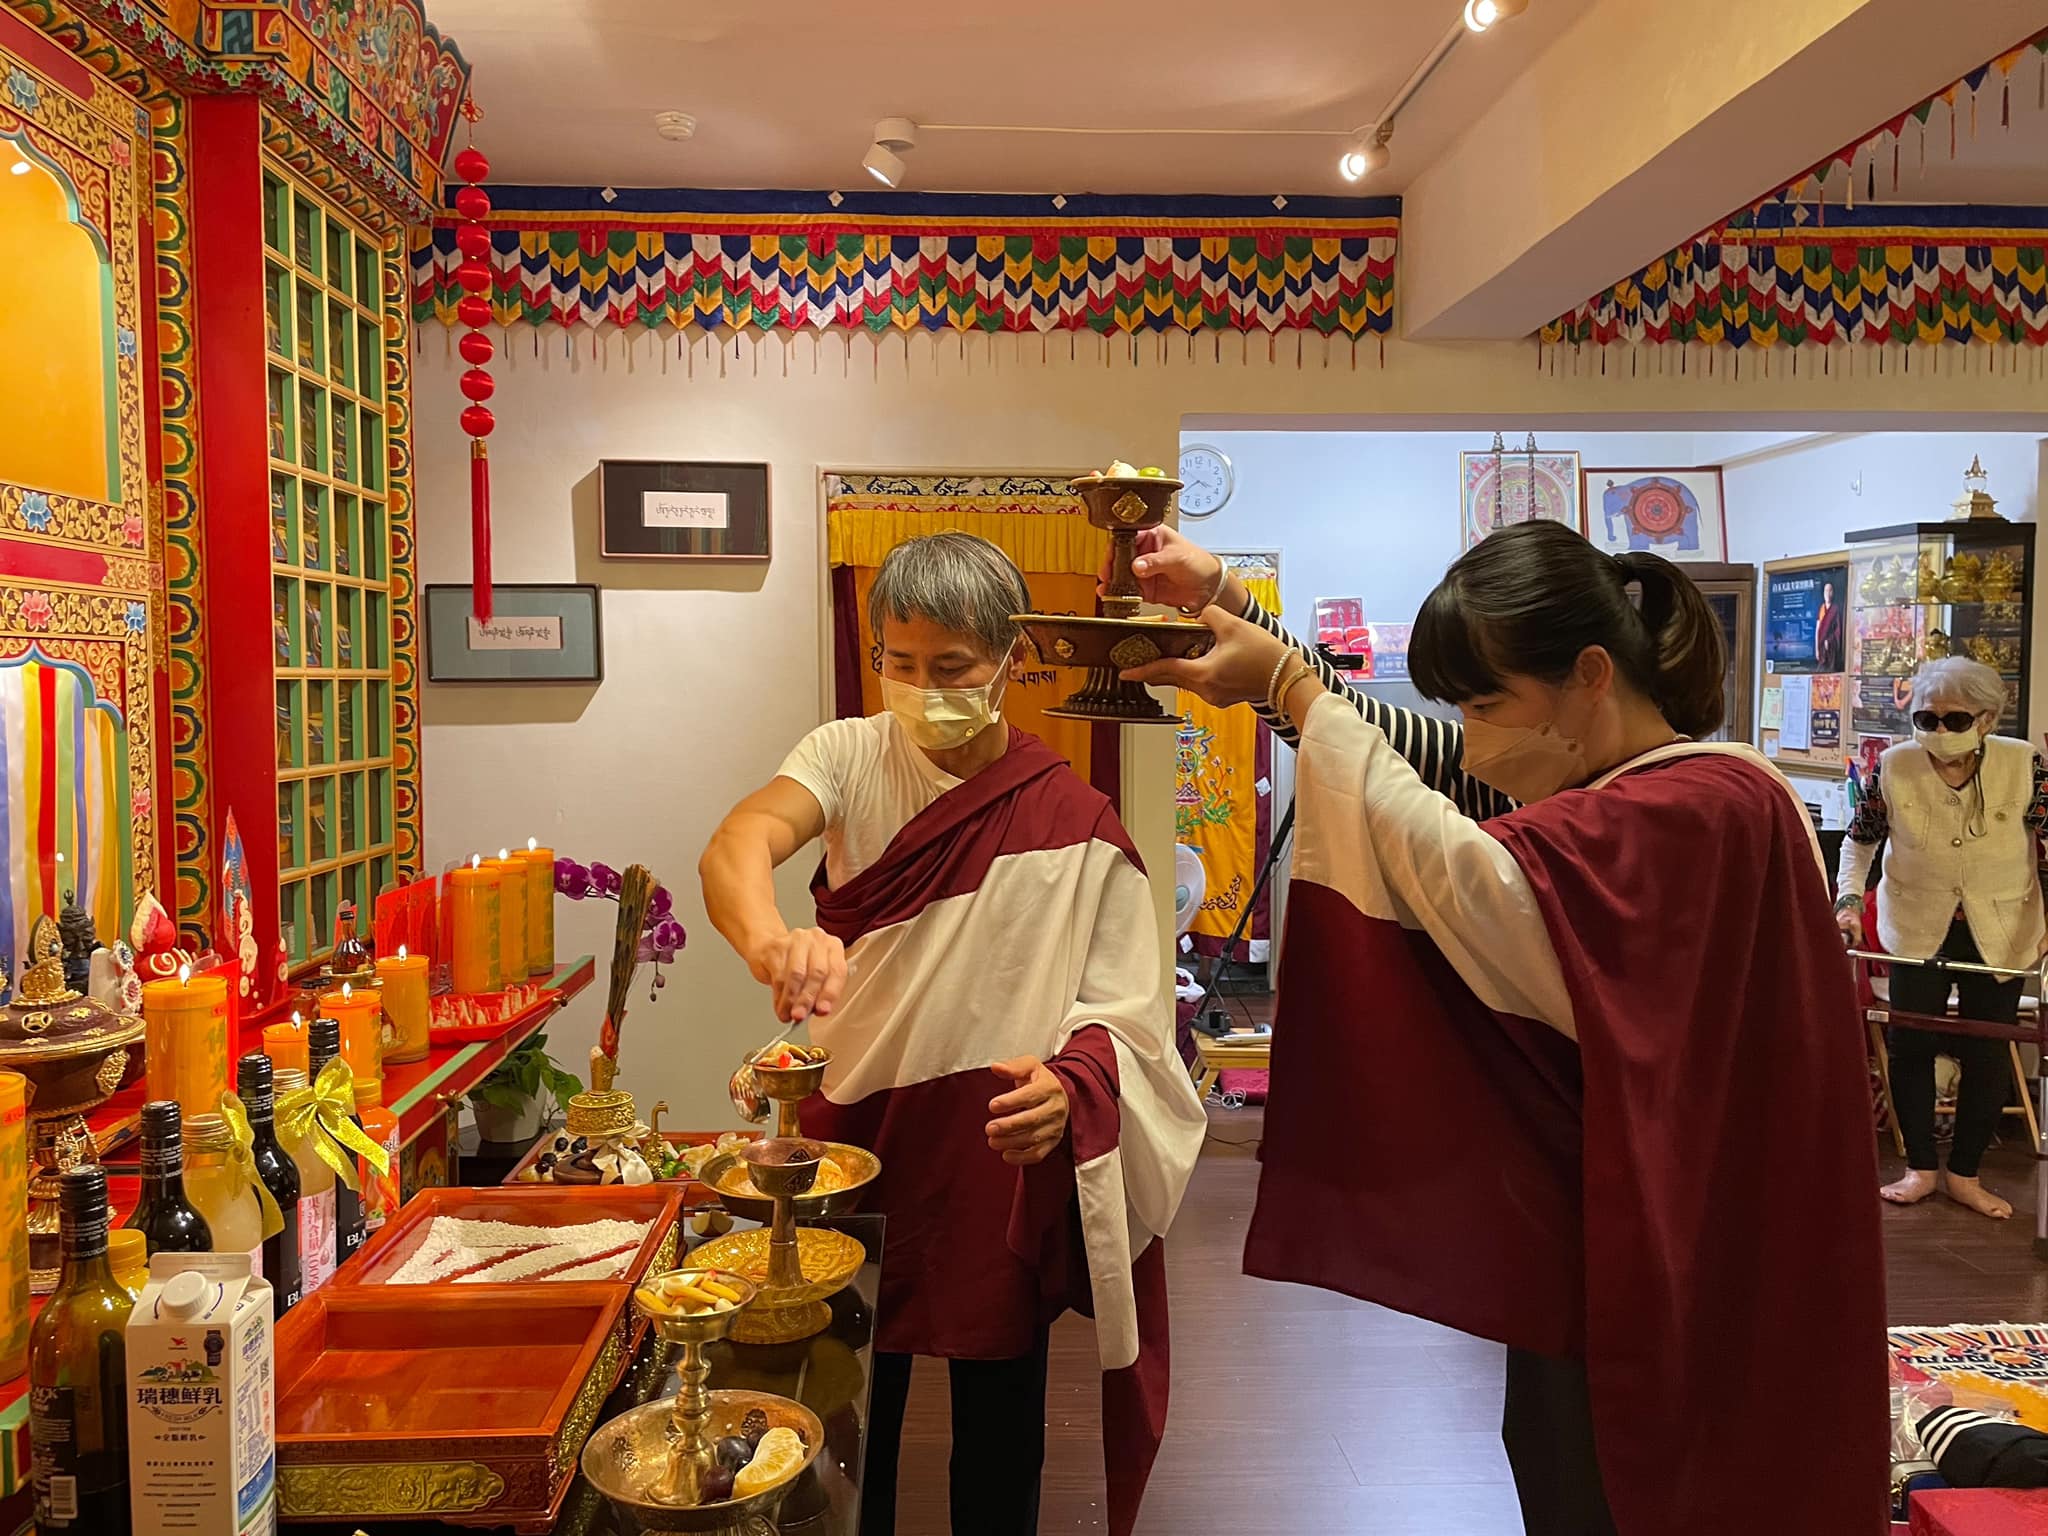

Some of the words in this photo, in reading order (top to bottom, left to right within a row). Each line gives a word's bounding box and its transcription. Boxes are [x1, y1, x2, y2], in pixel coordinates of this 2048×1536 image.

[1185, 459, 1193, 468] 11
[1213, 466, 1220, 475] 2
[1216, 477, 1223, 486] 3
[1184, 495, 1191, 505] 7
[1194, 498, 1201, 507] 6
[1206, 495, 1212, 504] 5
[287, 1290, 302, 1307] BL
[136, 1387, 223, 1405] 瑞穗鮮乳
